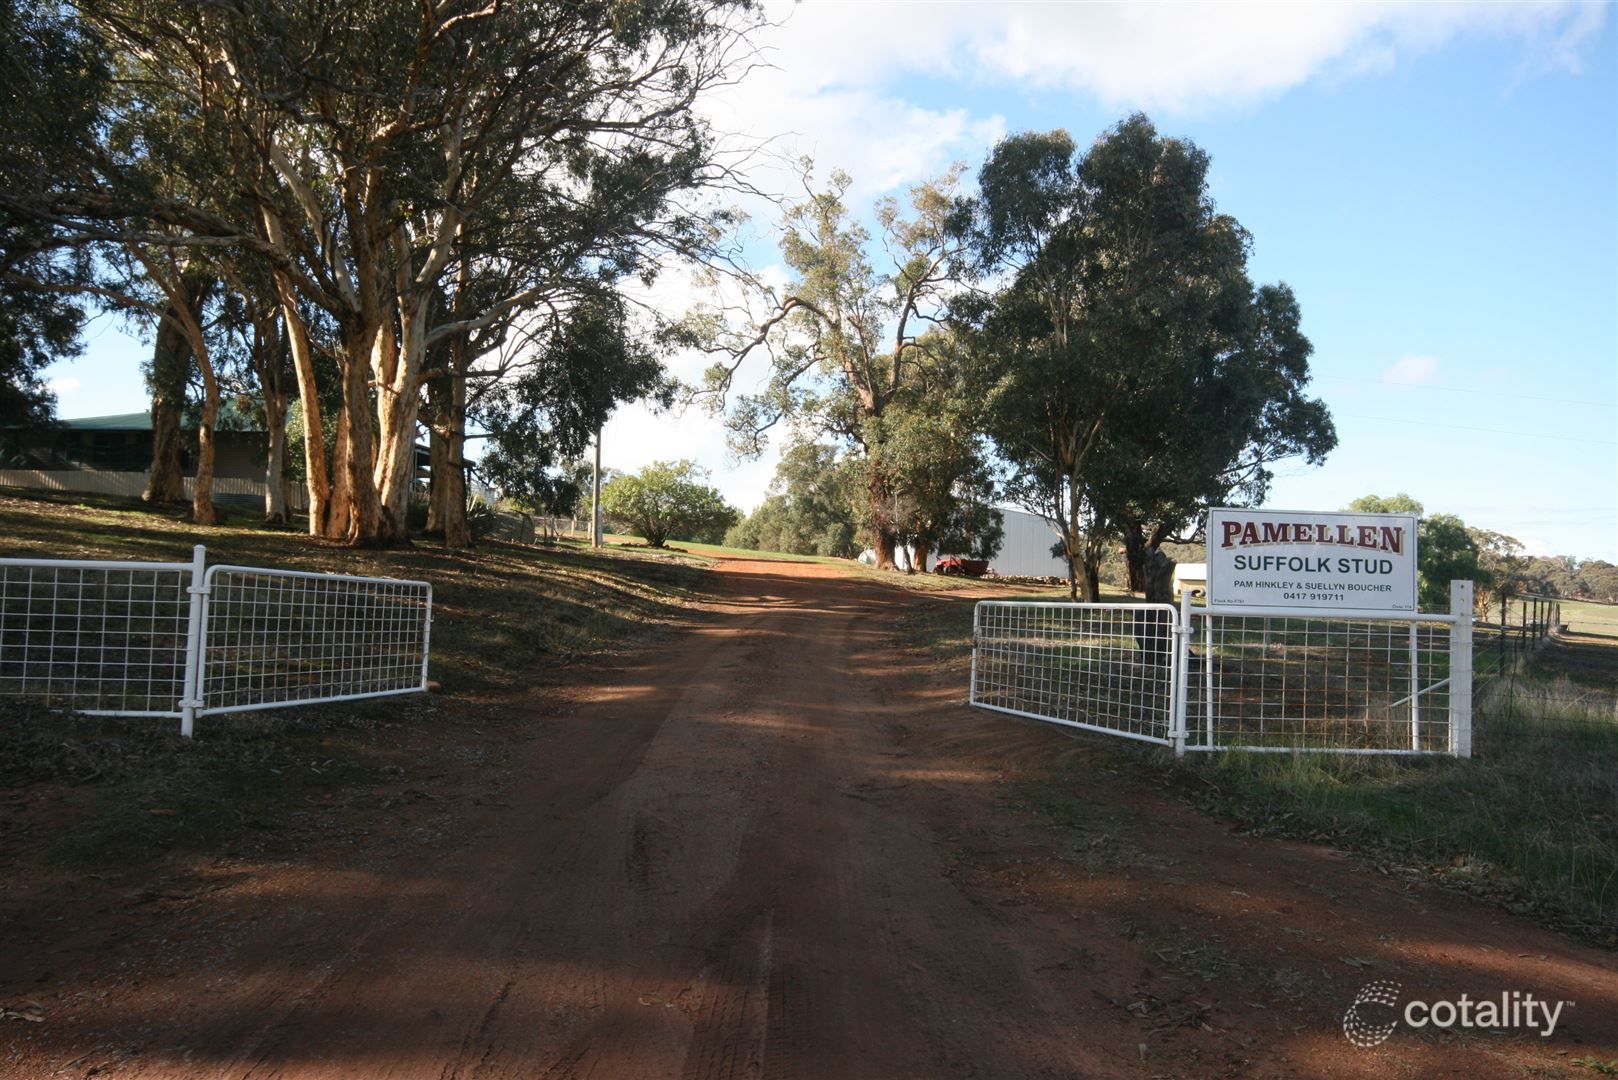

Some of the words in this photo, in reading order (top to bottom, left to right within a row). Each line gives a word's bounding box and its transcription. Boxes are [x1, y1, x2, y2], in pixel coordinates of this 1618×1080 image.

[1221, 521, 1405, 555] PAMELLEN
[1234, 555, 1331, 573] SUFFOLK
[1338, 558, 1393, 575] STUD
[1234, 580, 1253, 588] PAM
[1255, 581, 1294, 589] HINKLEY
[1305, 583, 1345, 591] SUELLYN
[1347, 584, 1392, 592] BOUCHER
[1283, 592, 1307, 600] 0417
[1310, 593, 1344, 601] 919711
